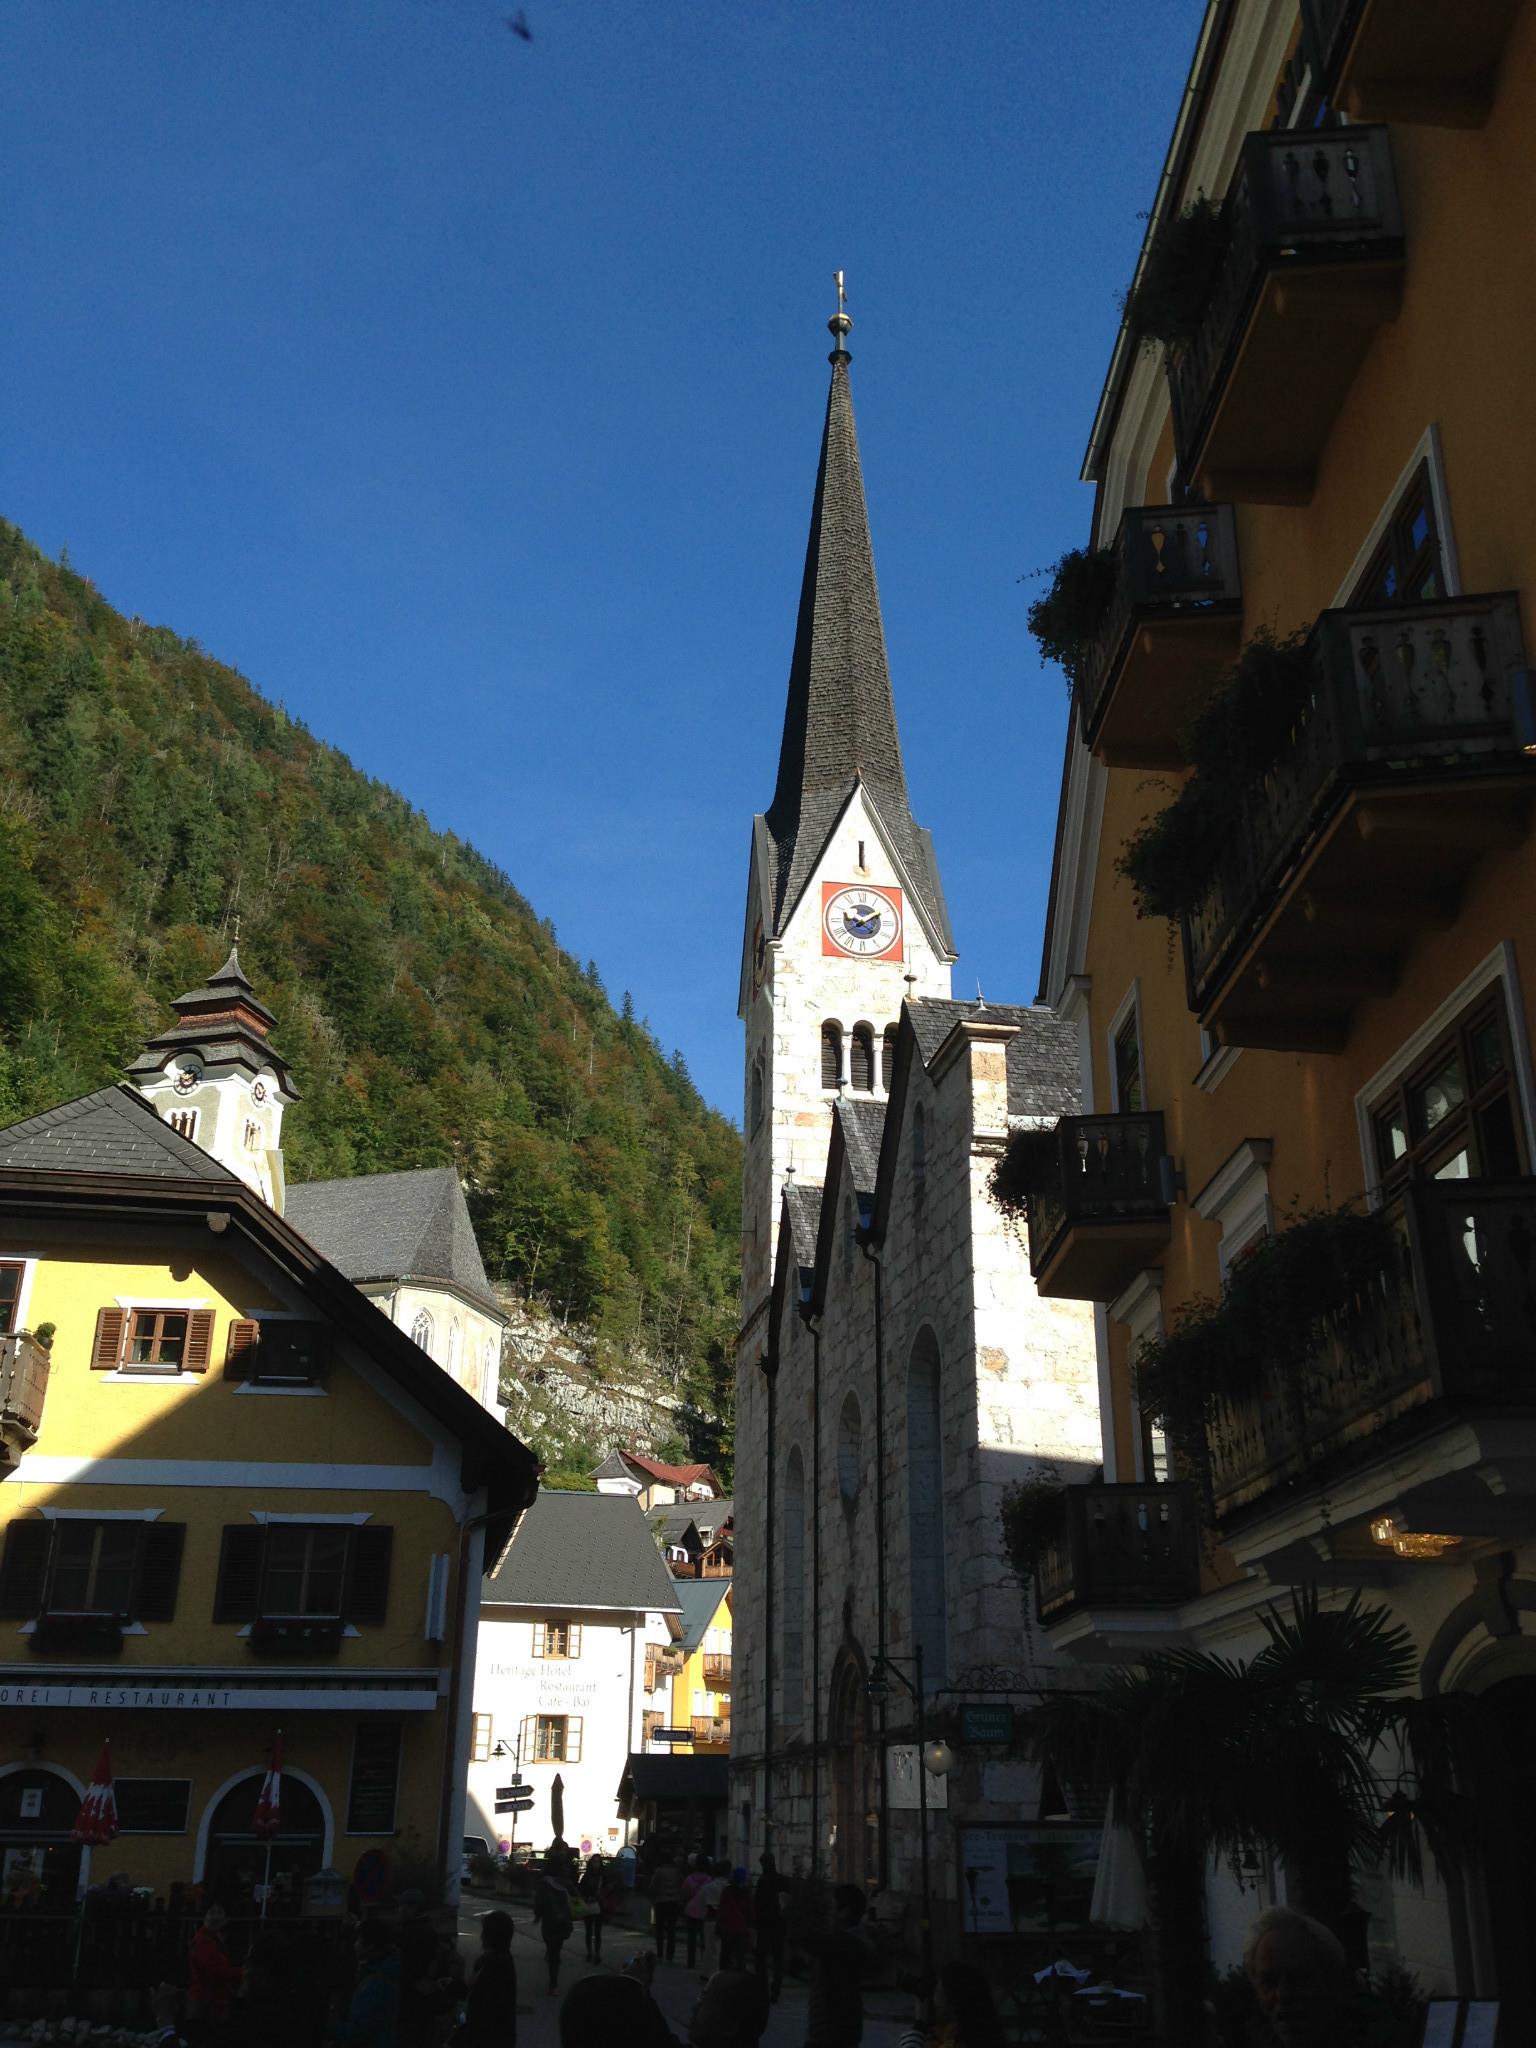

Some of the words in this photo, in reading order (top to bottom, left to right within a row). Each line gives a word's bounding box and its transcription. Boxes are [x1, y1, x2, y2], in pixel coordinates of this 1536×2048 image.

[540, 1663, 572, 1677] Hotel
[540, 1680, 597, 1692] Restaurant
[90, 1690, 231, 1705] RESTAURANT
[572, 1696, 590, 1707] Bar
